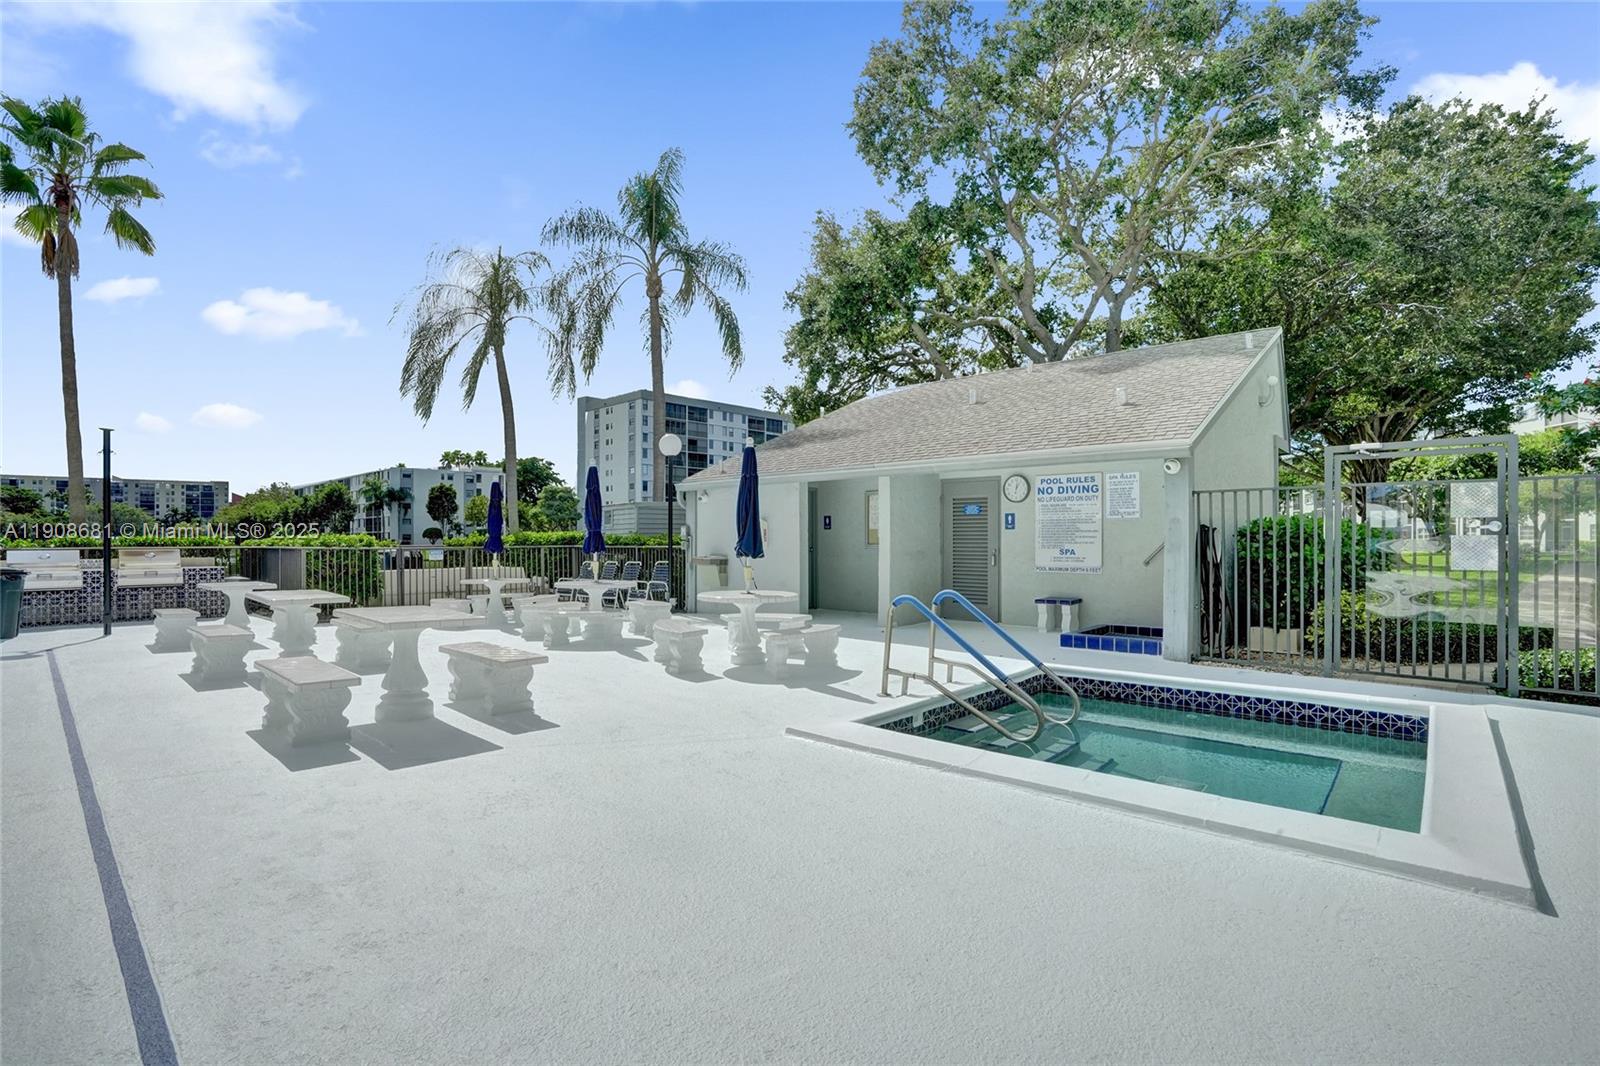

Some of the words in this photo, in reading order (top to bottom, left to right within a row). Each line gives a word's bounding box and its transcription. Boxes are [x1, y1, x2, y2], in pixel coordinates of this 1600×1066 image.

[1066, 476, 1096, 484] RULES
[1037, 487, 1054, 495] NO
[1057, 485, 1100, 494] DIVING
[1059, 548, 1076, 556] SPA
